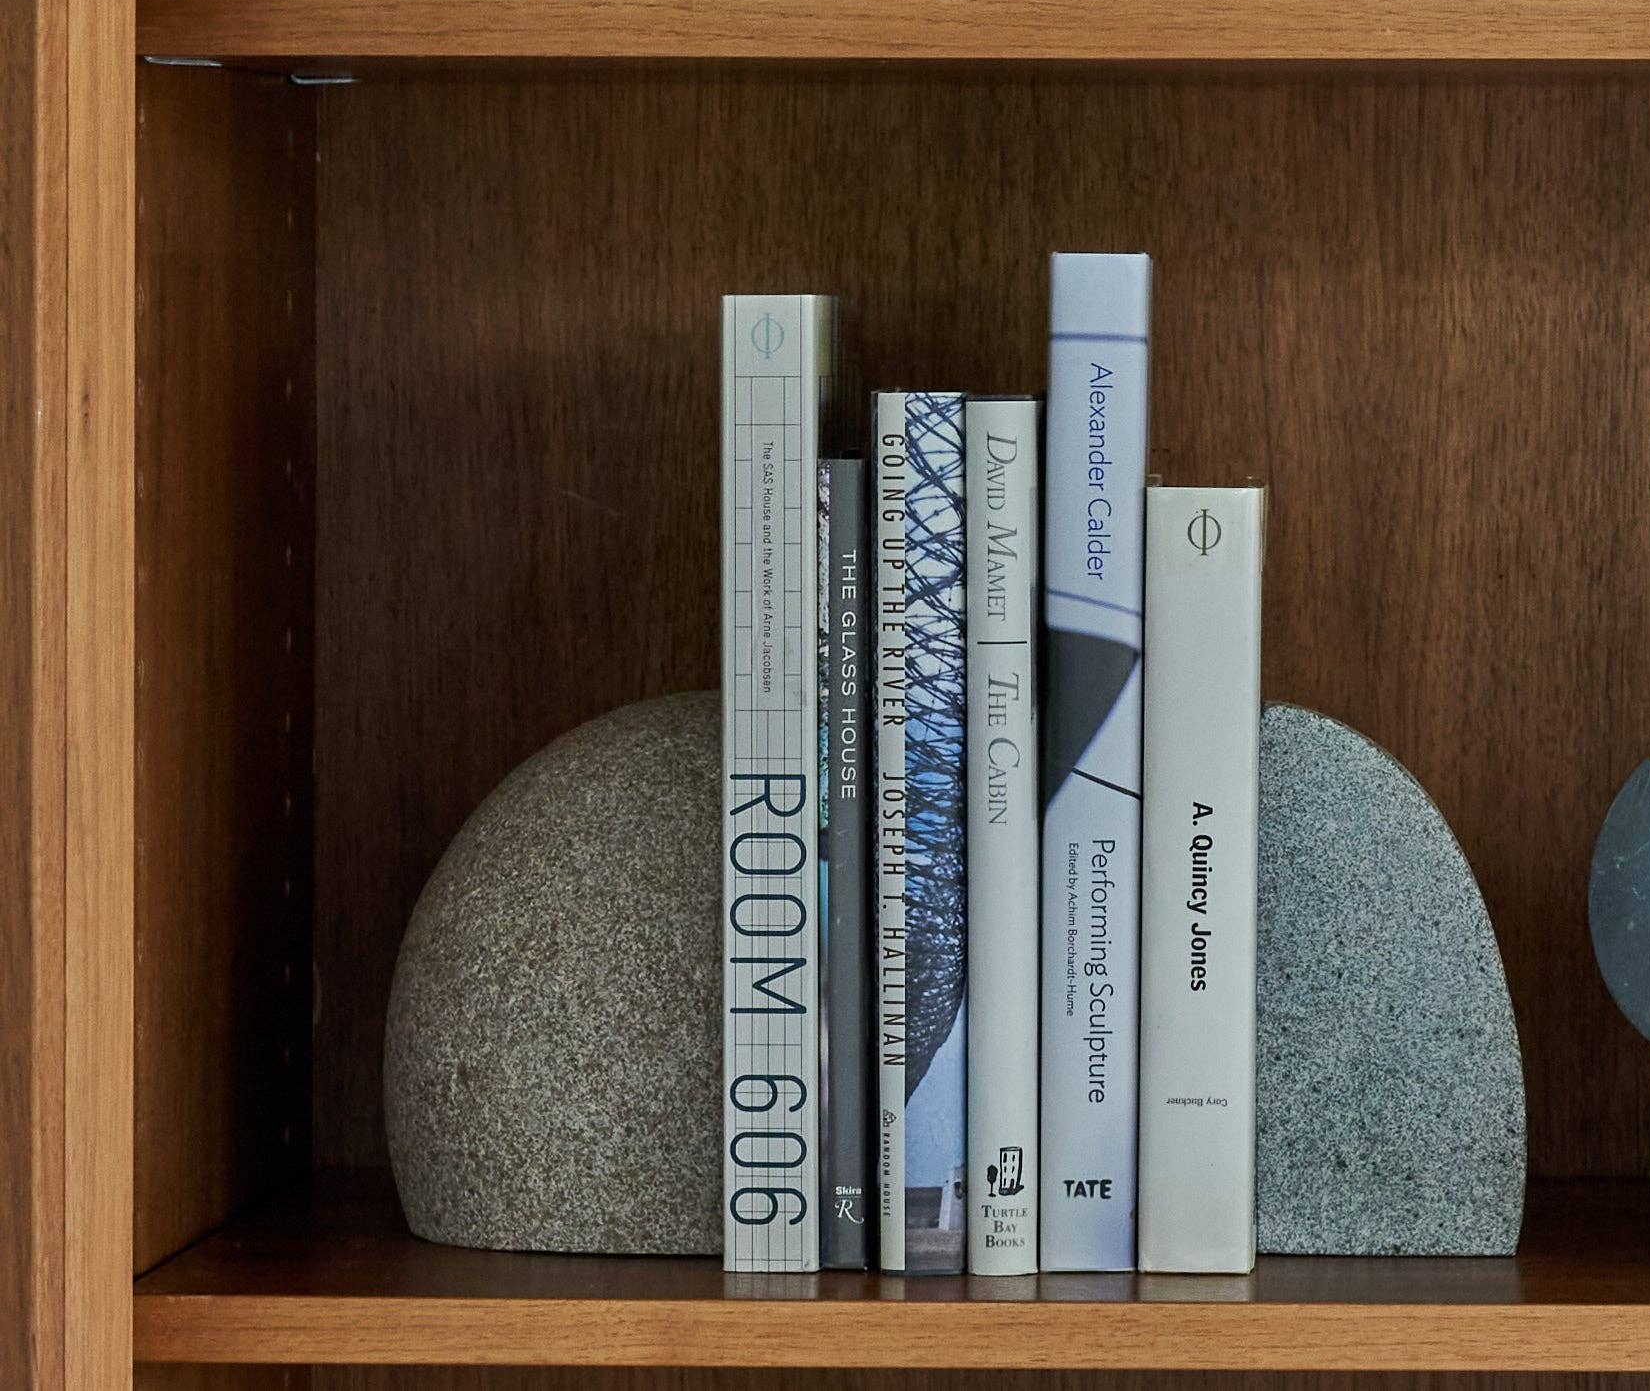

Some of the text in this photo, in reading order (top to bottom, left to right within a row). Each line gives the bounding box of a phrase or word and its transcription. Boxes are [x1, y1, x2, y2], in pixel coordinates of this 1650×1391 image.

[987, 430, 1018, 622] DAVID MAMET
[1087, 362, 1114, 581] Alexander Calder
[763, 441, 773, 693] The SAS House and the Work of Arne Jacobsen
[882, 434, 905, 726] GOING UP THE RIVER
[841, 549, 857, 799] THE GLASS HOUSE
[988, 672, 1021, 826] THE CABIN
[882, 772, 905, 1066] JOSEPH T. HALLINAN
[1066, 842, 1079, 1016] Edited by Achim Borchardt-Hume
[1082, 839, 1116, 1104] Performing Sculpture
[1186, 801, 1214, 991] A. Quincy Jones
[729, 773, 807, 1226] ROOM 606
[835, 1186, 862, 1195] Skira
[883, 1132, 891, 1216] RANDOM HOUSE
[1063, 1179, 1113, 1199] TATE
[1206, 1096, 1228, 1107] Cory
[981, 1204, 1028, 1218] TURTLE
[985, 1234, 1025, 1248] BOOKS
[993, 1220, 1017, 1233] BAY
